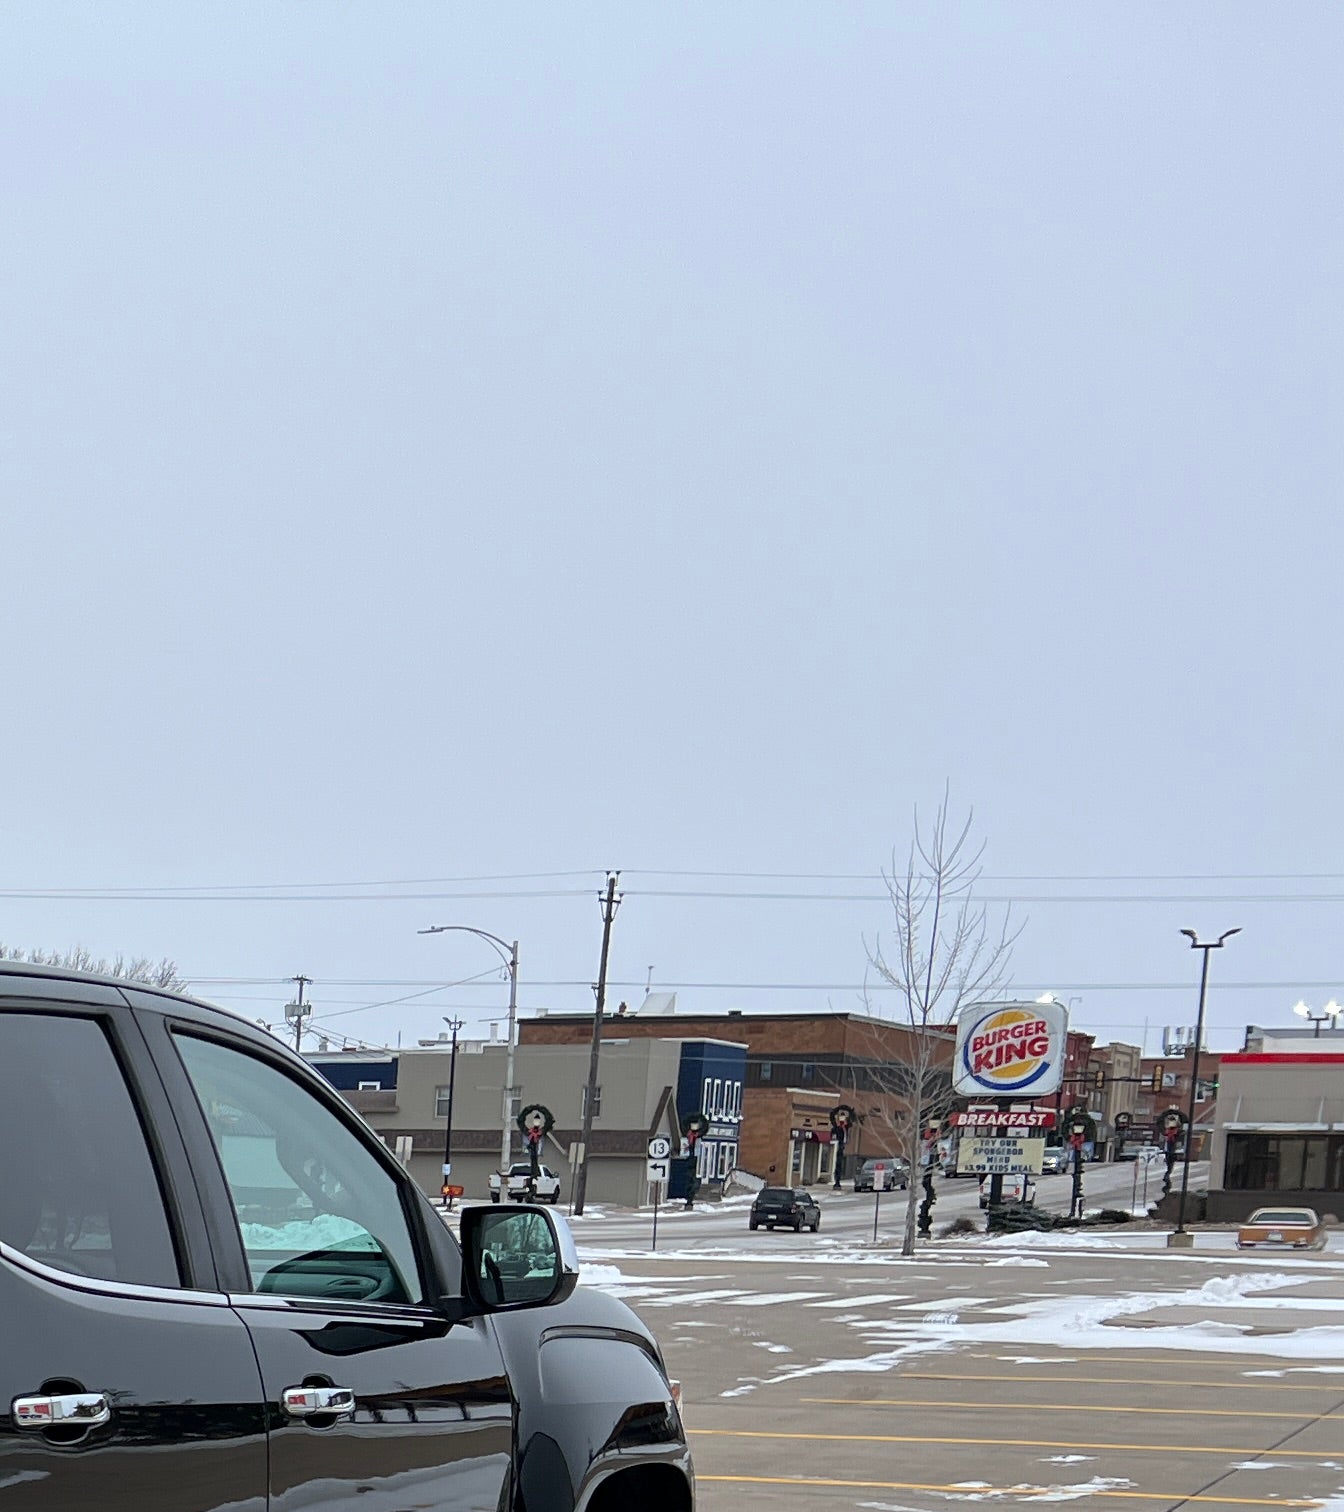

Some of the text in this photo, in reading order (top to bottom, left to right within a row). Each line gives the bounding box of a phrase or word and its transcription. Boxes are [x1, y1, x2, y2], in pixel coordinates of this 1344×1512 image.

[972, 1021, 1047, 1053] BURGER
[973, 1037, 1049, 1074] KING
[957, 1113, 1048, 1126] BREAKFAST
[653, 1142, 665, 1155] 13
[989, 1164, 1009, 1172] KIDS
[1011, 1164, 1034, 1172] MEAL
